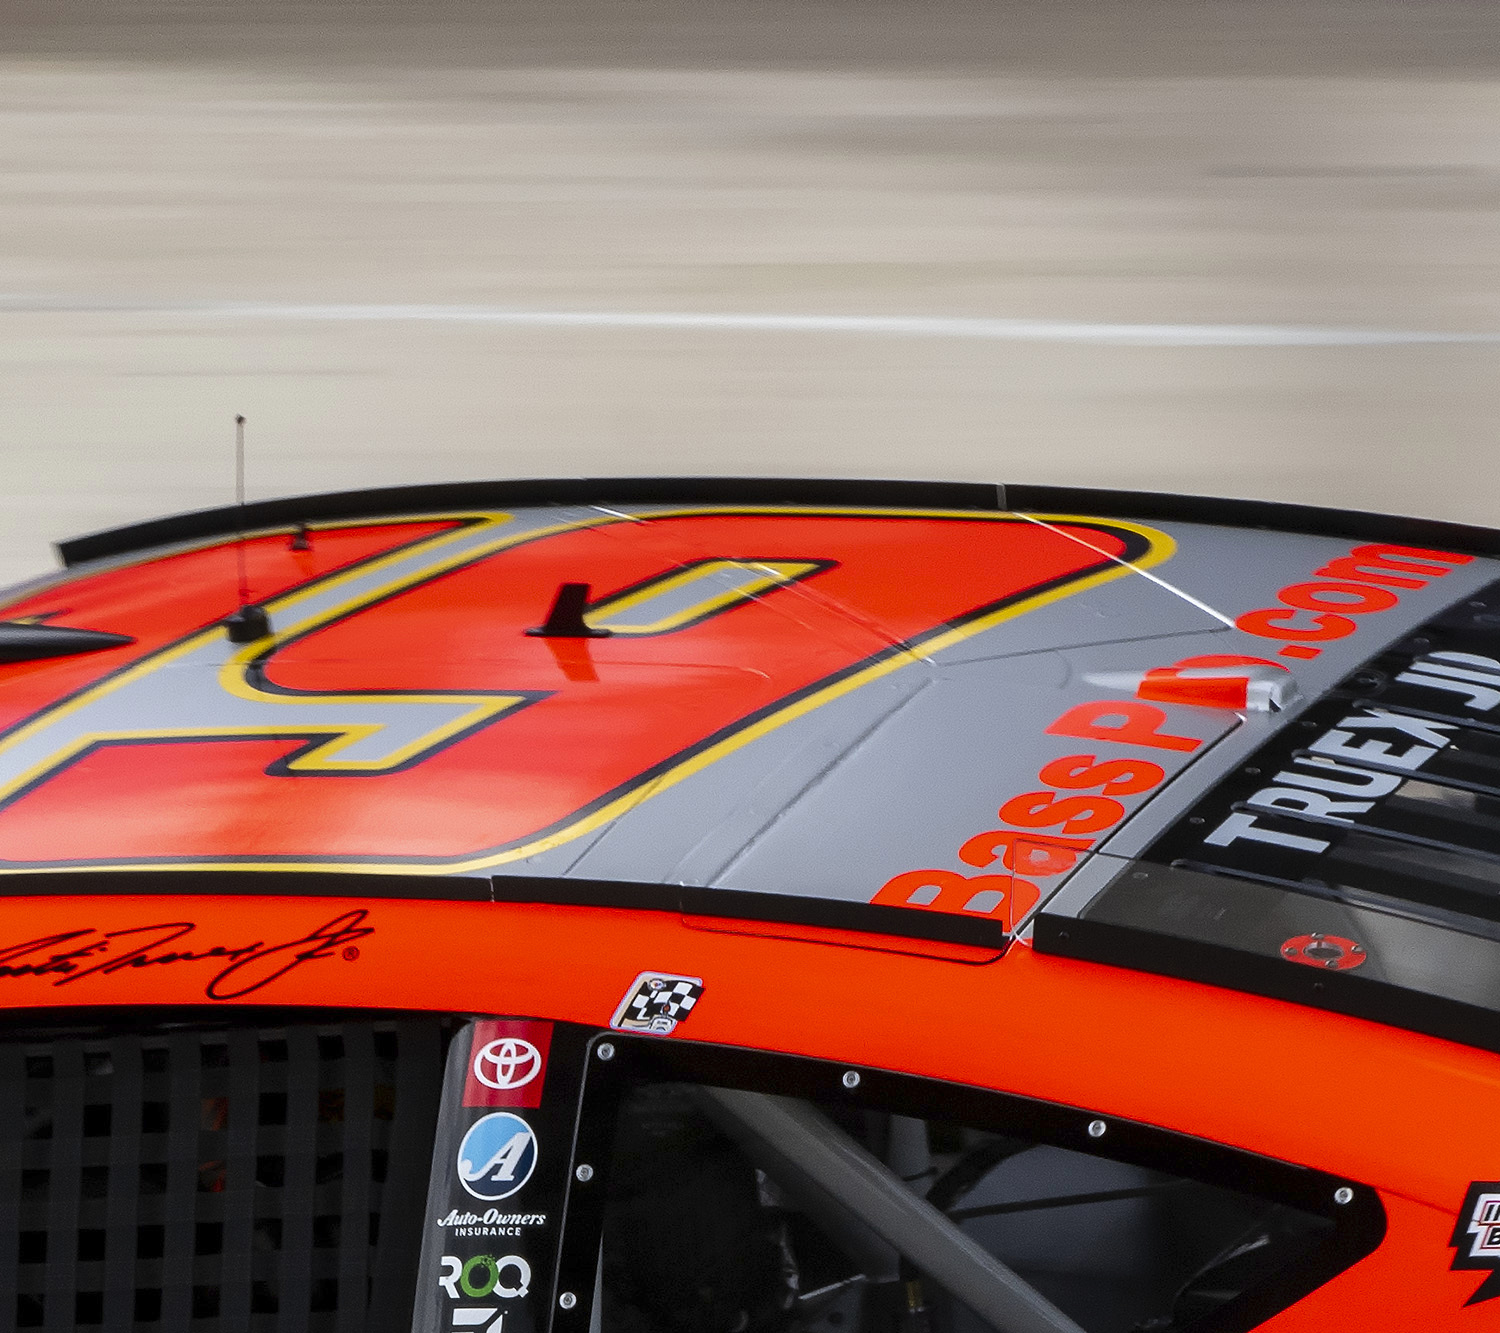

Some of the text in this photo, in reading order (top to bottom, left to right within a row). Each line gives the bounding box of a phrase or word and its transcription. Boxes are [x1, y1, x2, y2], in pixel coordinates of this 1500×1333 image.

[1203, 707, 1461, 853] TRUEX
[437, 1208, 546, 1228] Auto-Owners
[454, 1226, 522, 1237] INSURANCE
[438, 1254, 532, 1299] ROQ
